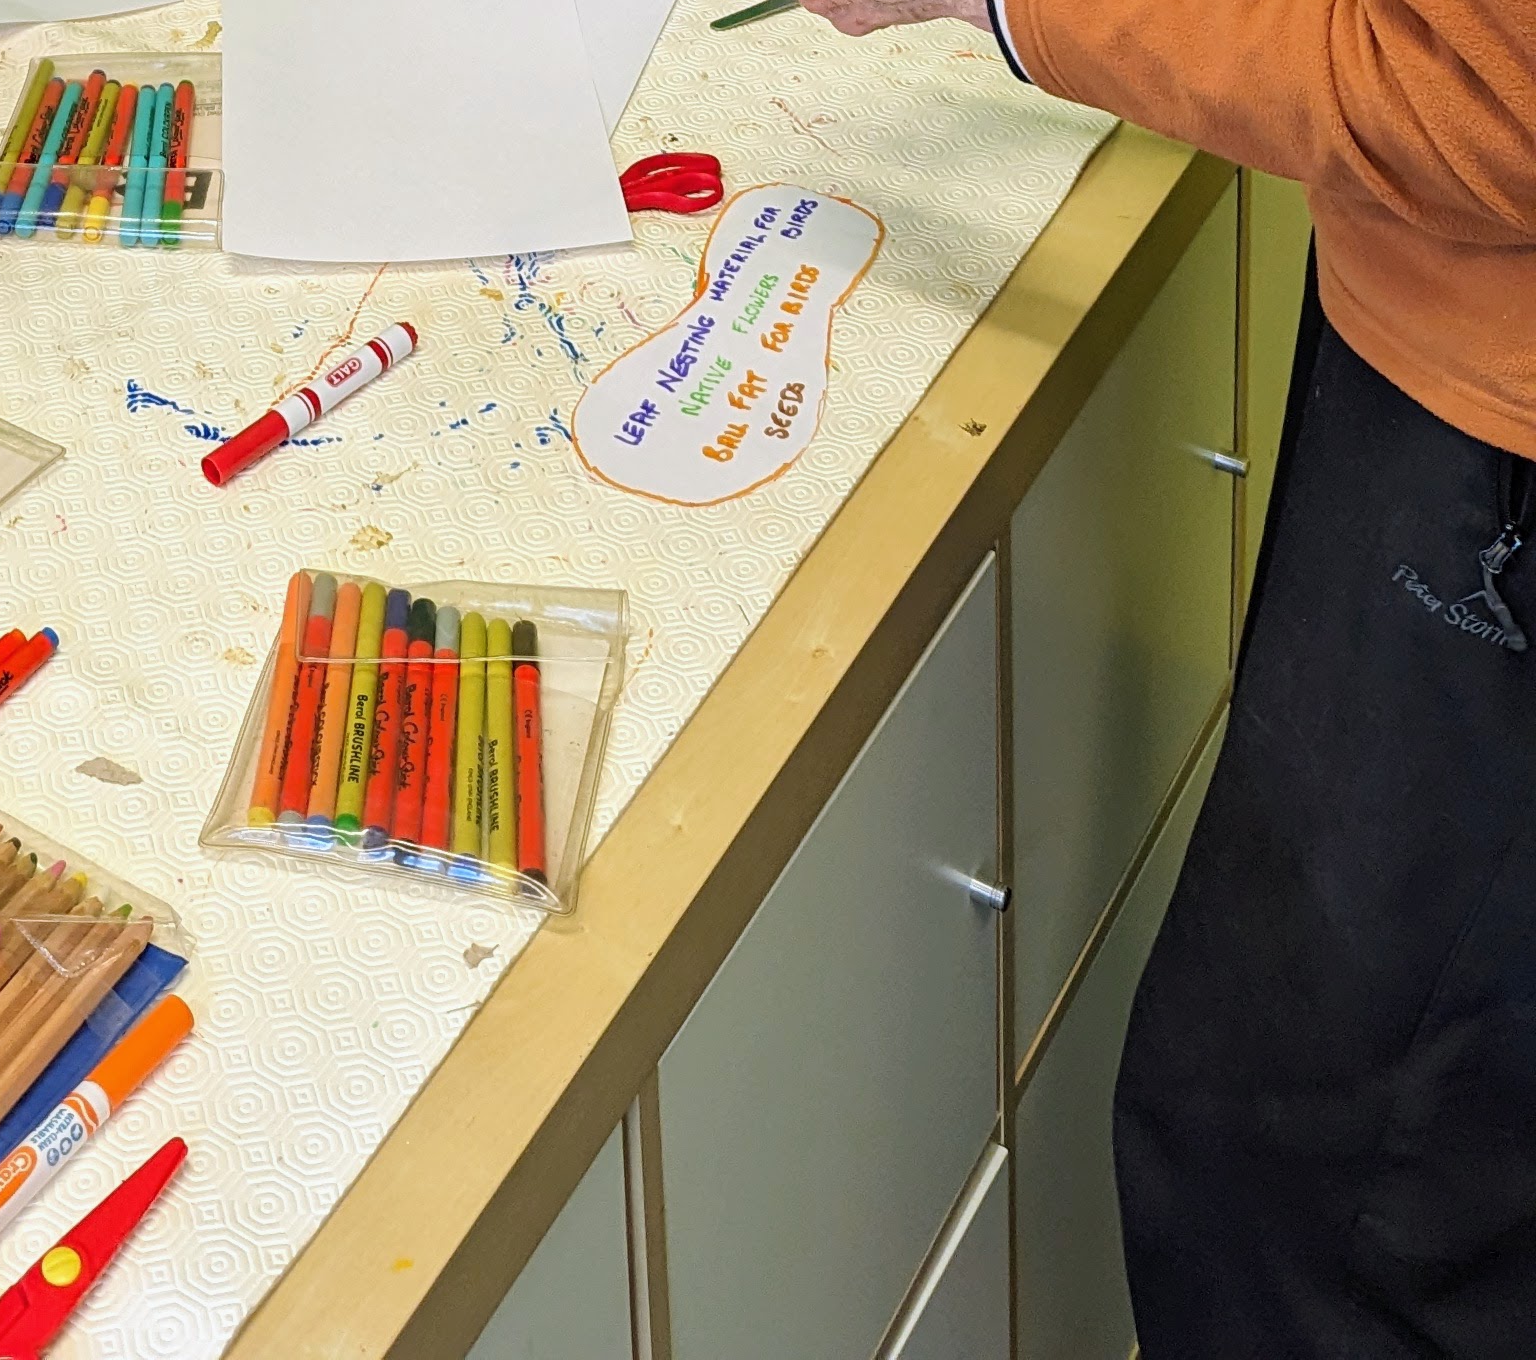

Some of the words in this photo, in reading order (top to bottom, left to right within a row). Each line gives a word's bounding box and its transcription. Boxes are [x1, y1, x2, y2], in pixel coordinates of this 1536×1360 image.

[780, 198, 820, 240] BIRDS
[614, 398, 661, 446] LEAF
[656, 314, 716, 392] NESTING
[709, 232, 767, 302] MATERIAL
[754, 206, 782, 239] FOR
[681, 354, 734, 417] NATIVE
[731, 273, 781, 335] FLOWERS
[727, 369, 768, 410] FAT
[760, 321, 795, 353] FOR
[780, 263, 821, 316] BIRDS
[331, 357, 361, 385] GALT
[764, 381, 806, 440] SEEDS
[1391, 564, 1443, 613] Peter
[355, 693, 369, 722] Berol
[347, 722, 367, 784] BRUSHLINE
